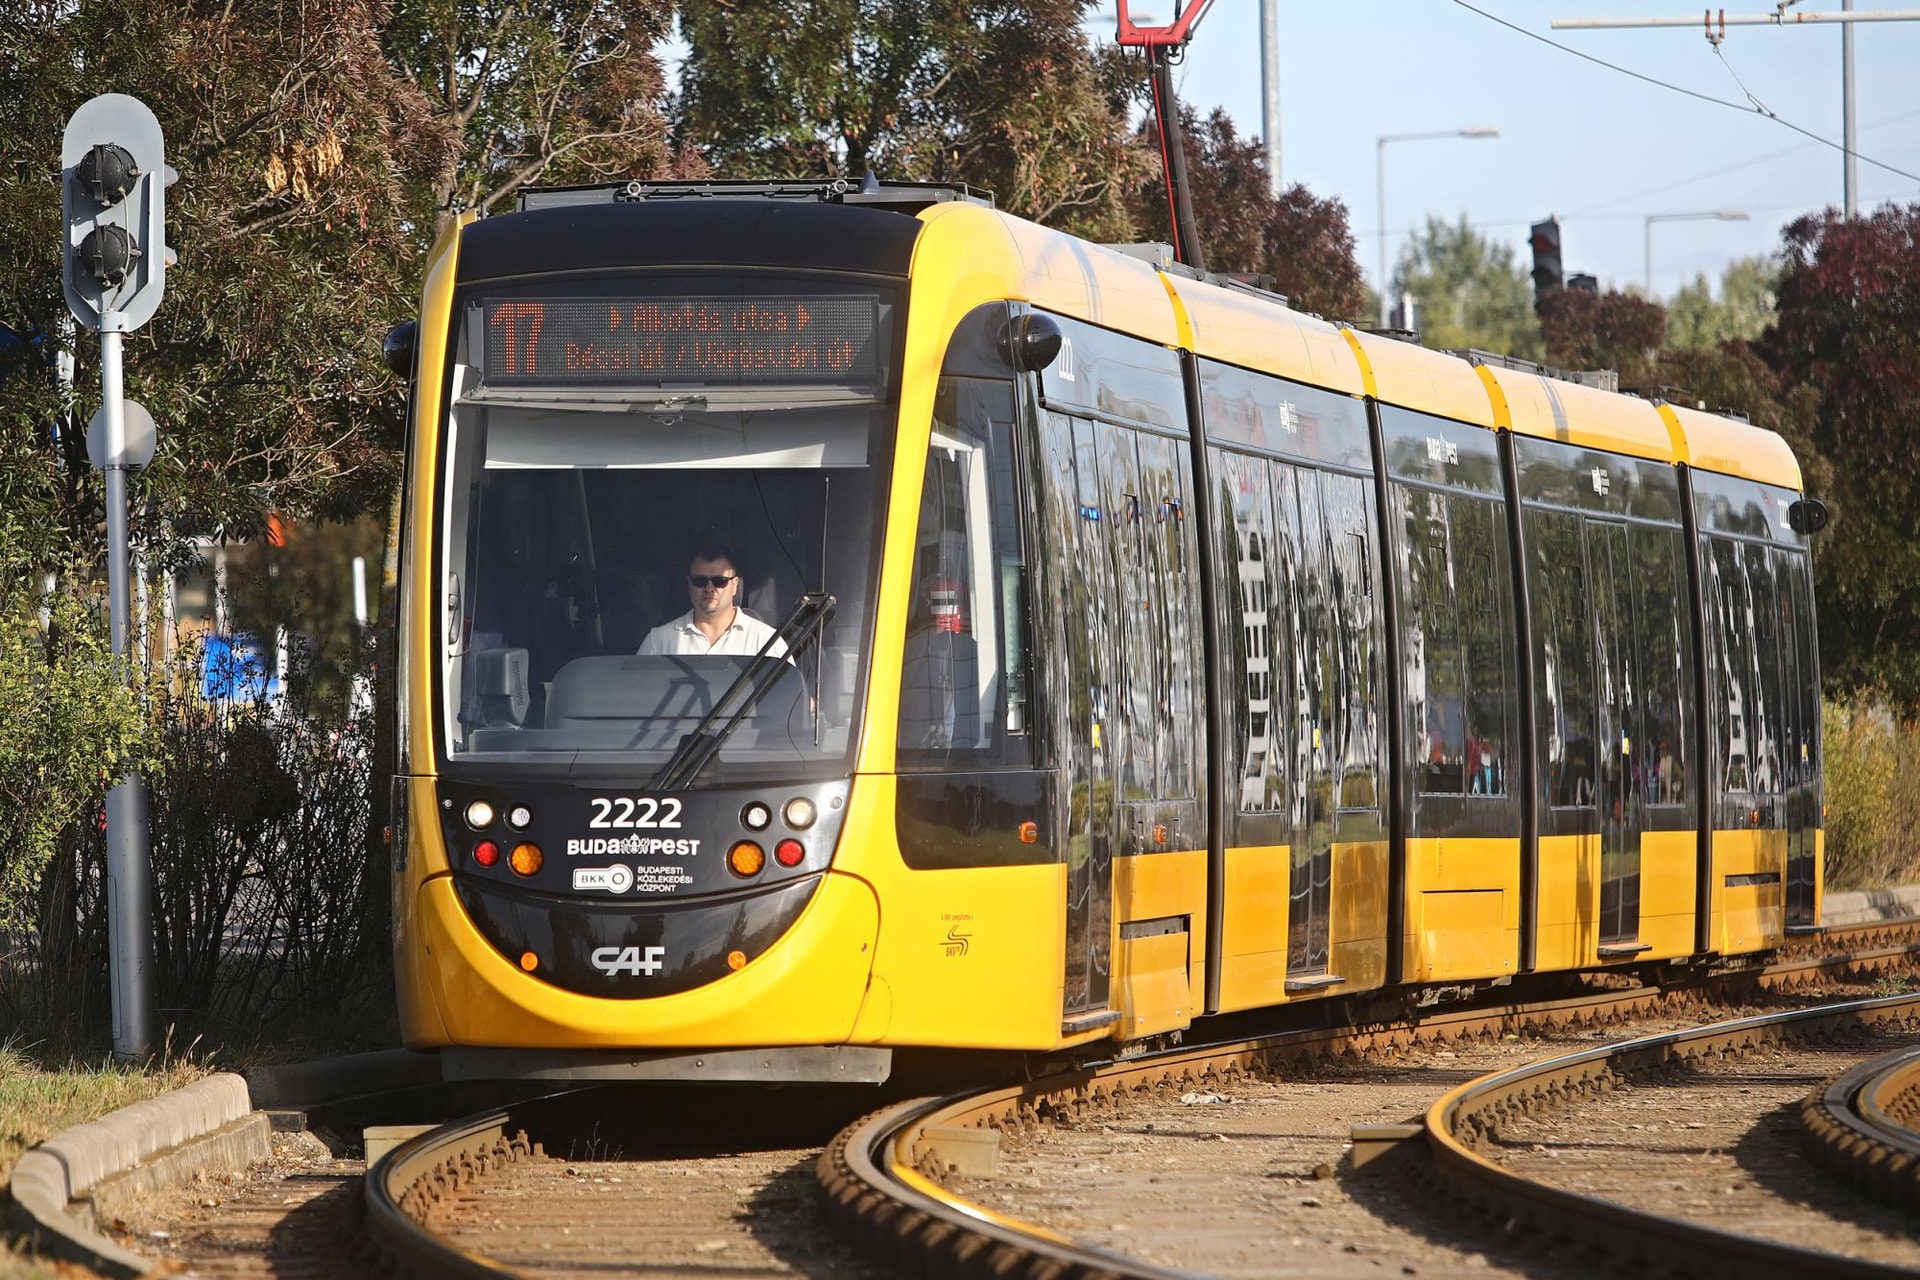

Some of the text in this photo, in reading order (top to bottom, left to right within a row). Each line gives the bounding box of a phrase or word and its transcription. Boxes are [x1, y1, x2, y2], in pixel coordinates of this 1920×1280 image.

[632, 304, 789, 331] Alkotás utca
[490, 303, 545, 373] 17
[566, 342, 631, 370] Bécsi
[640, 338, 665, 369] út
[694, 340, 818, 369] Vörösvári
[827, 336, 852, 368] út
[590, 798, 682, 829] 2222
[581, 875, 605, 883] BKK
[637, 866, 683, 875] BUDAPESTI
[637, 874, 693, 884] KÖZLEKEDÉSI
[636, 883, 677, 892] KÖZPONT
[591, 946, 665, 976] CAF
